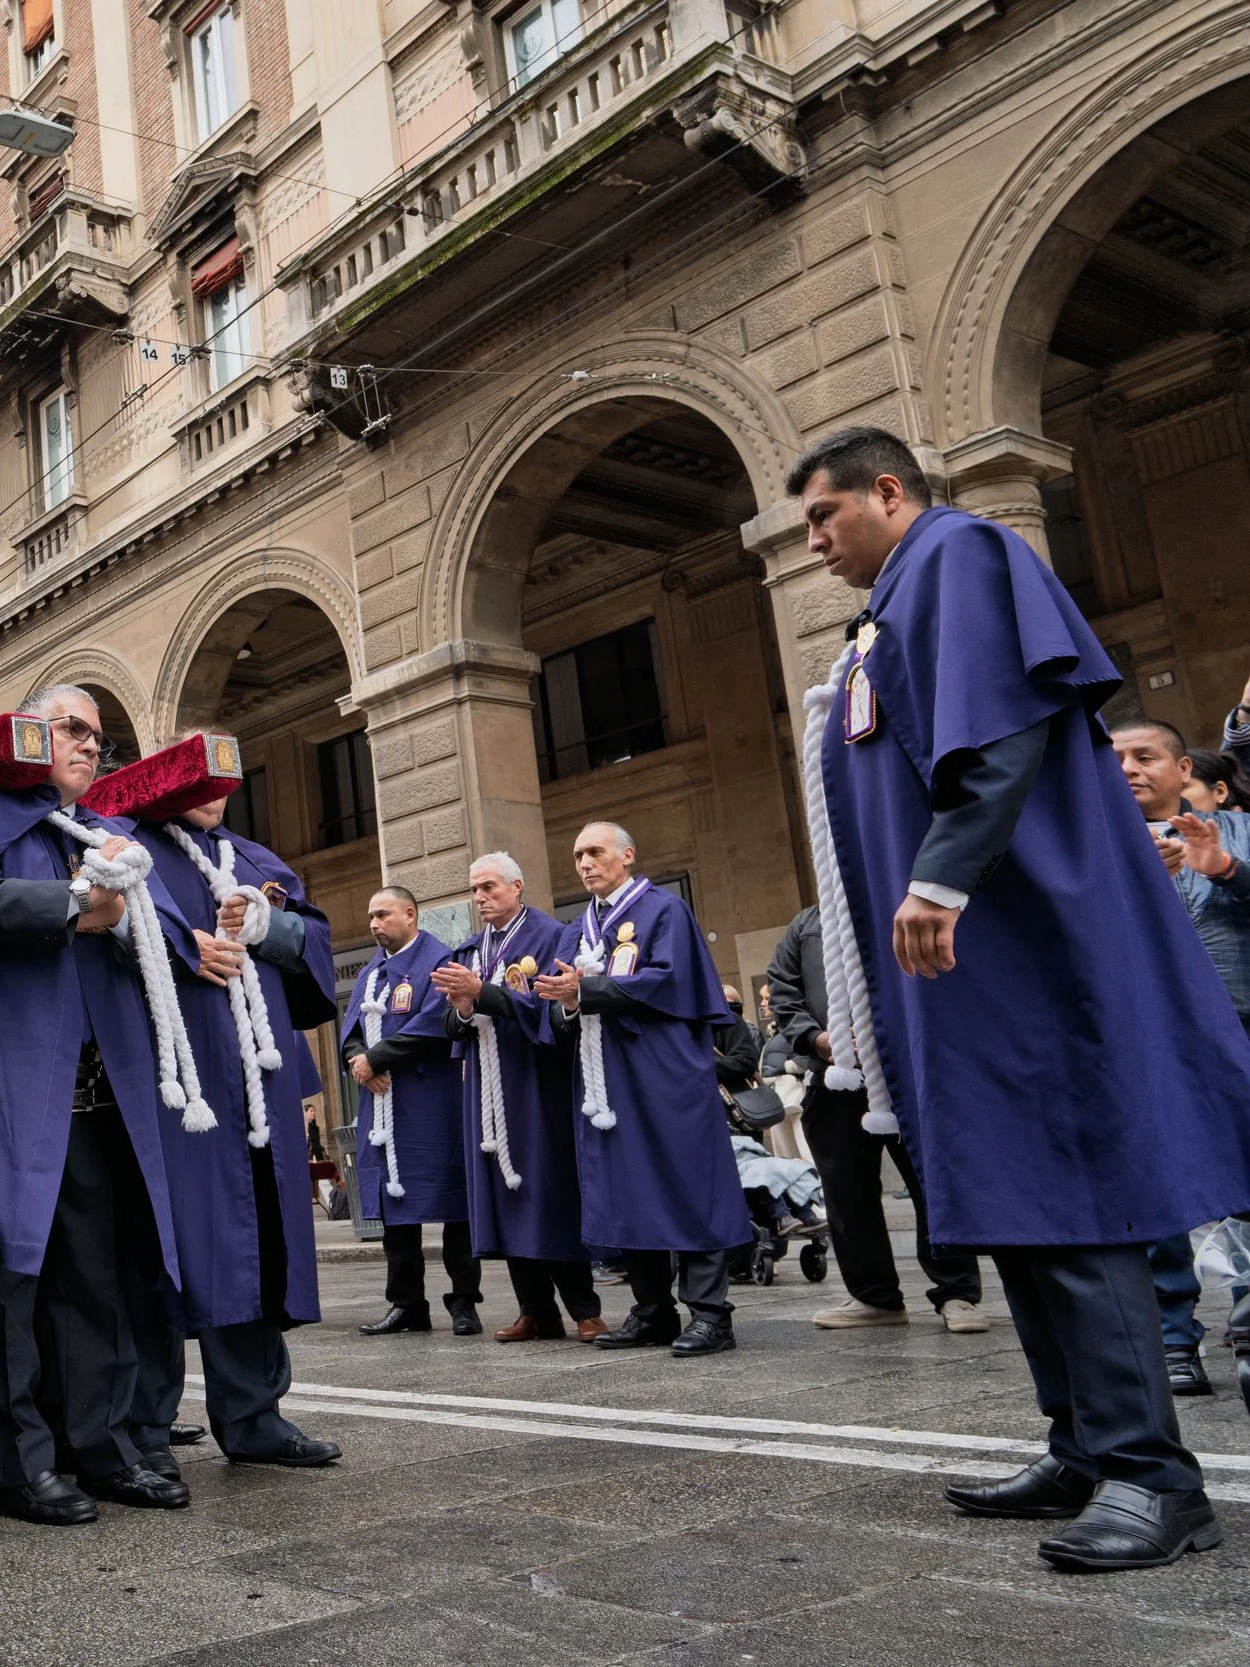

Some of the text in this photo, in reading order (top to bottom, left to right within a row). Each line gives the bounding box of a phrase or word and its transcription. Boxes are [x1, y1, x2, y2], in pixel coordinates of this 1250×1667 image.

[142, 348, 158, 360] 14
[171, 353, 186, 365] 15
[332, 374, 346, 385] 13
